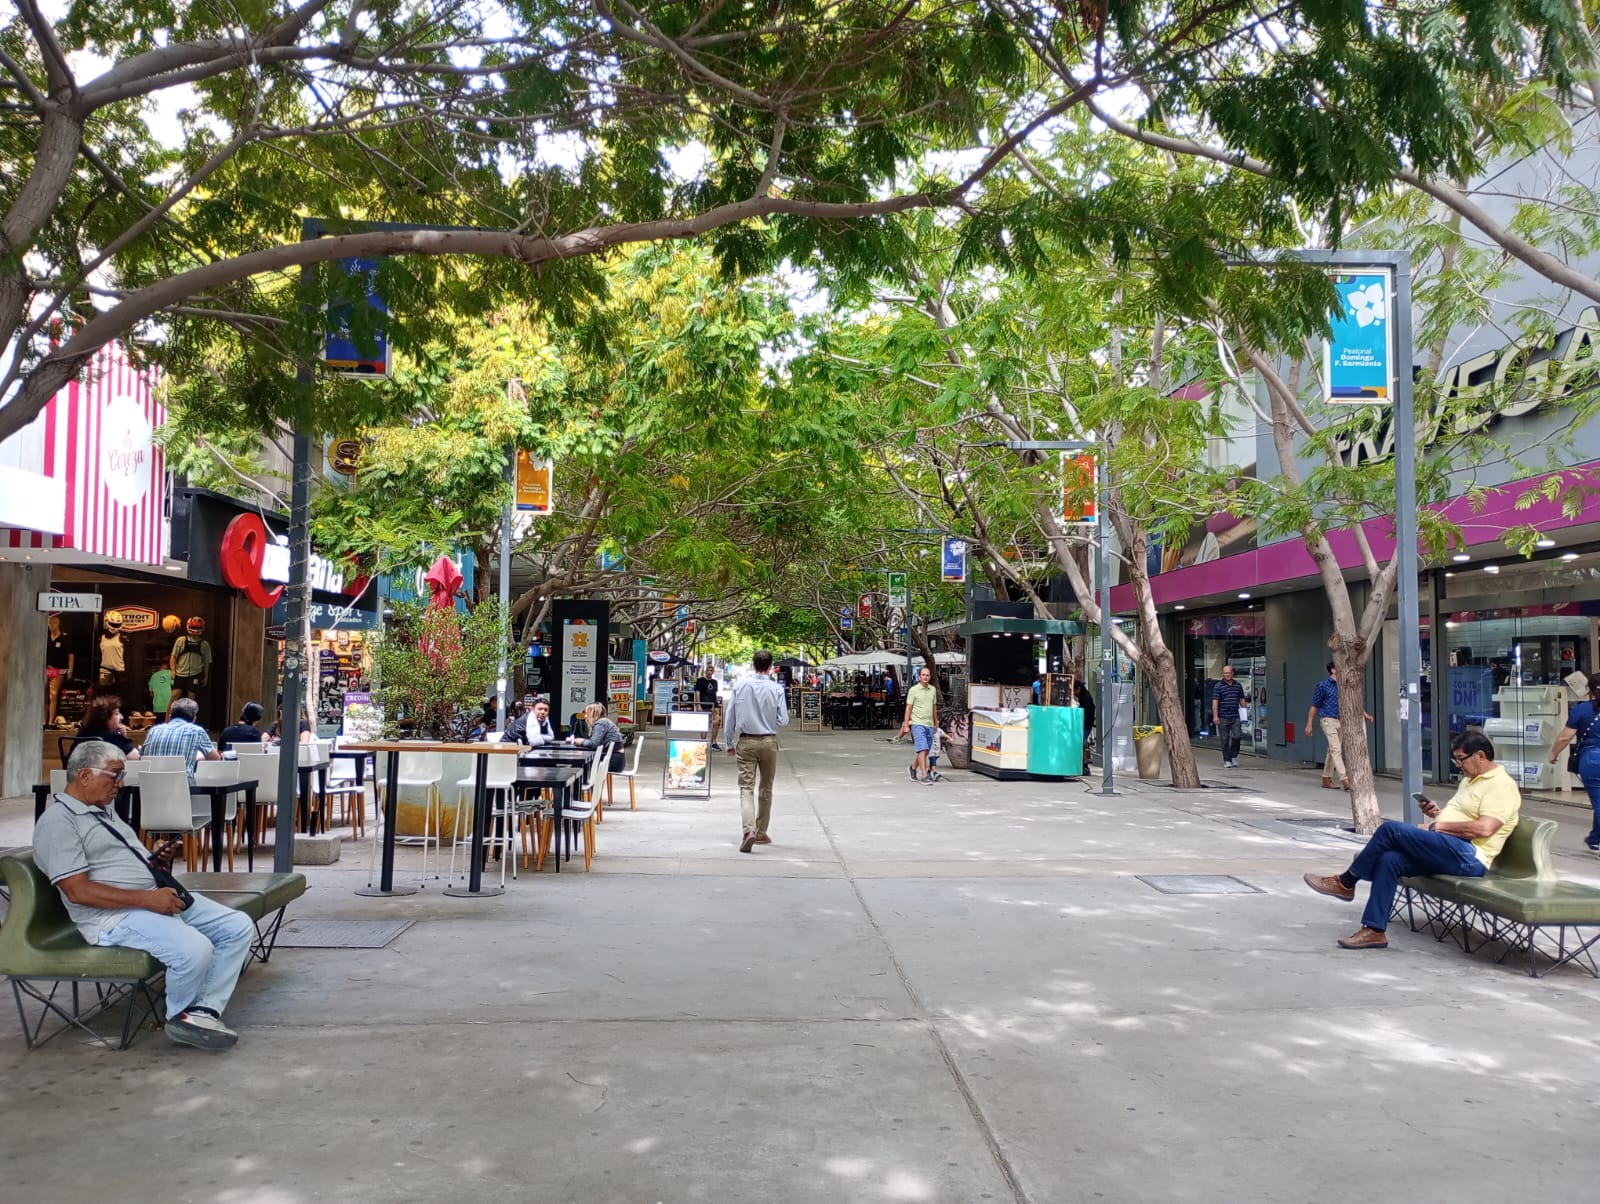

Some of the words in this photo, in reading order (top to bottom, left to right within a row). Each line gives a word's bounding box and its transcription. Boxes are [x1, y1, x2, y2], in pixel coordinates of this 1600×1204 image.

[1343, 347, 1372, 355] Peatonal
[1340, 354, 1375, 362] Domingo
[1342, 359, 1382, 367] Sarmiento
[48, 596, 80, 609] TIPA
